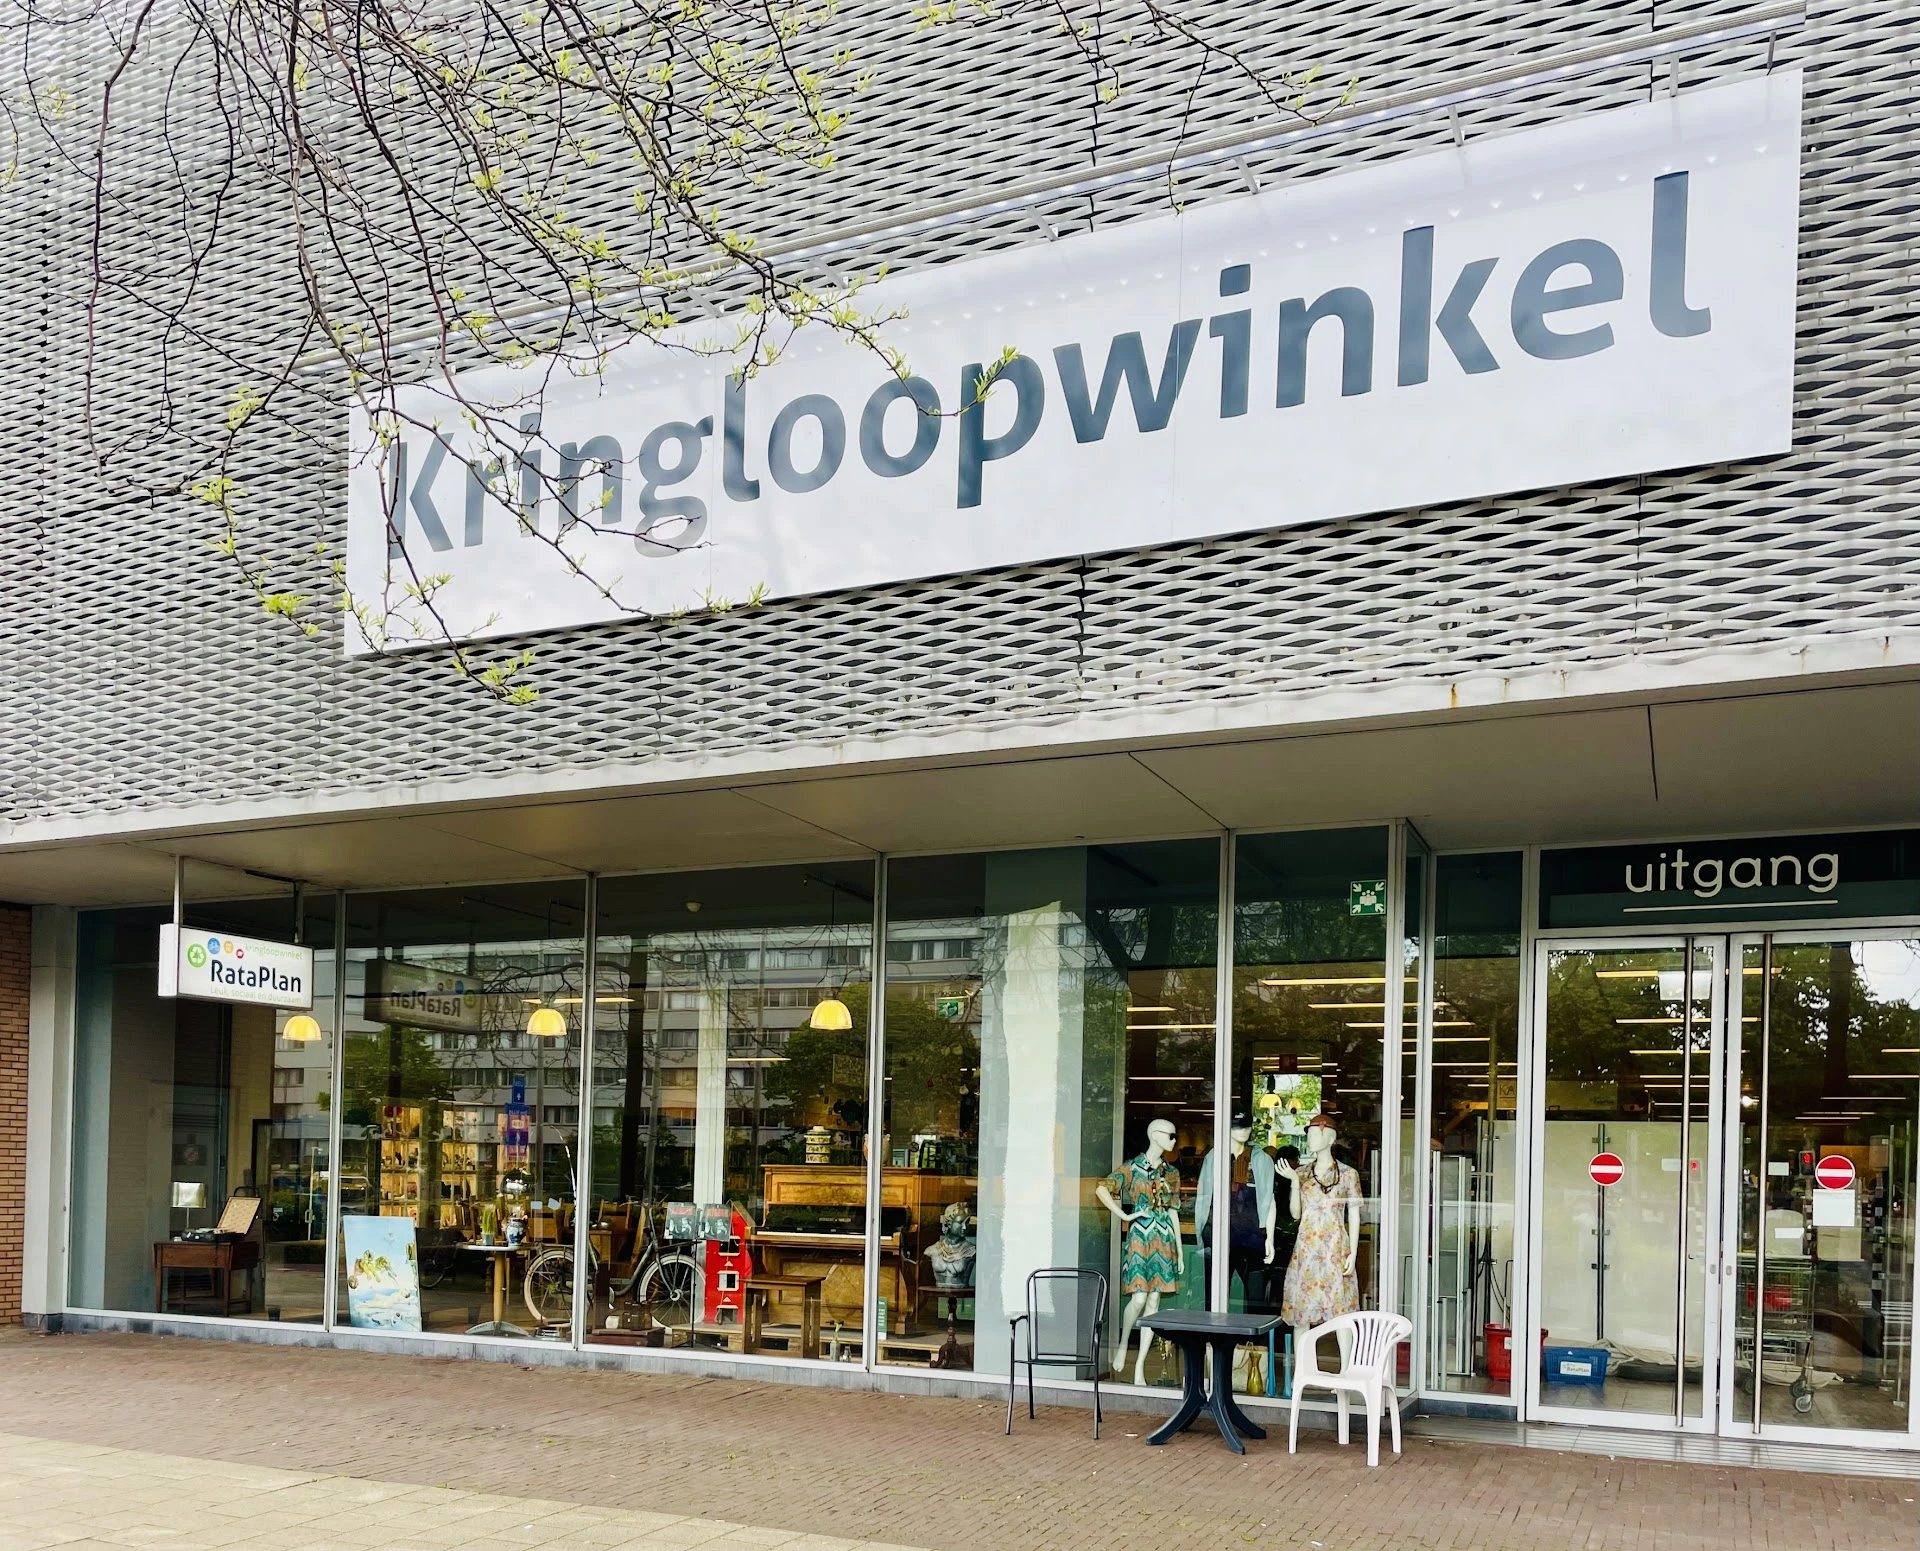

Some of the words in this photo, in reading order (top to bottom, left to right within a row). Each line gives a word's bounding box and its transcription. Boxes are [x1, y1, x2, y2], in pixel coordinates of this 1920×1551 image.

[388, 170, 1712, 559] Kringloopwinkel
[1625, 848, 1839, 898] uitgang
[245, 943, 303, 960] kringloopwinkel
[211, 959, 302, 993] RataPlan
[231, 988, 256, 999] sociaal
[258, 992, 267, 1001] en
[268, 991, 302, 1005] duurzaam
